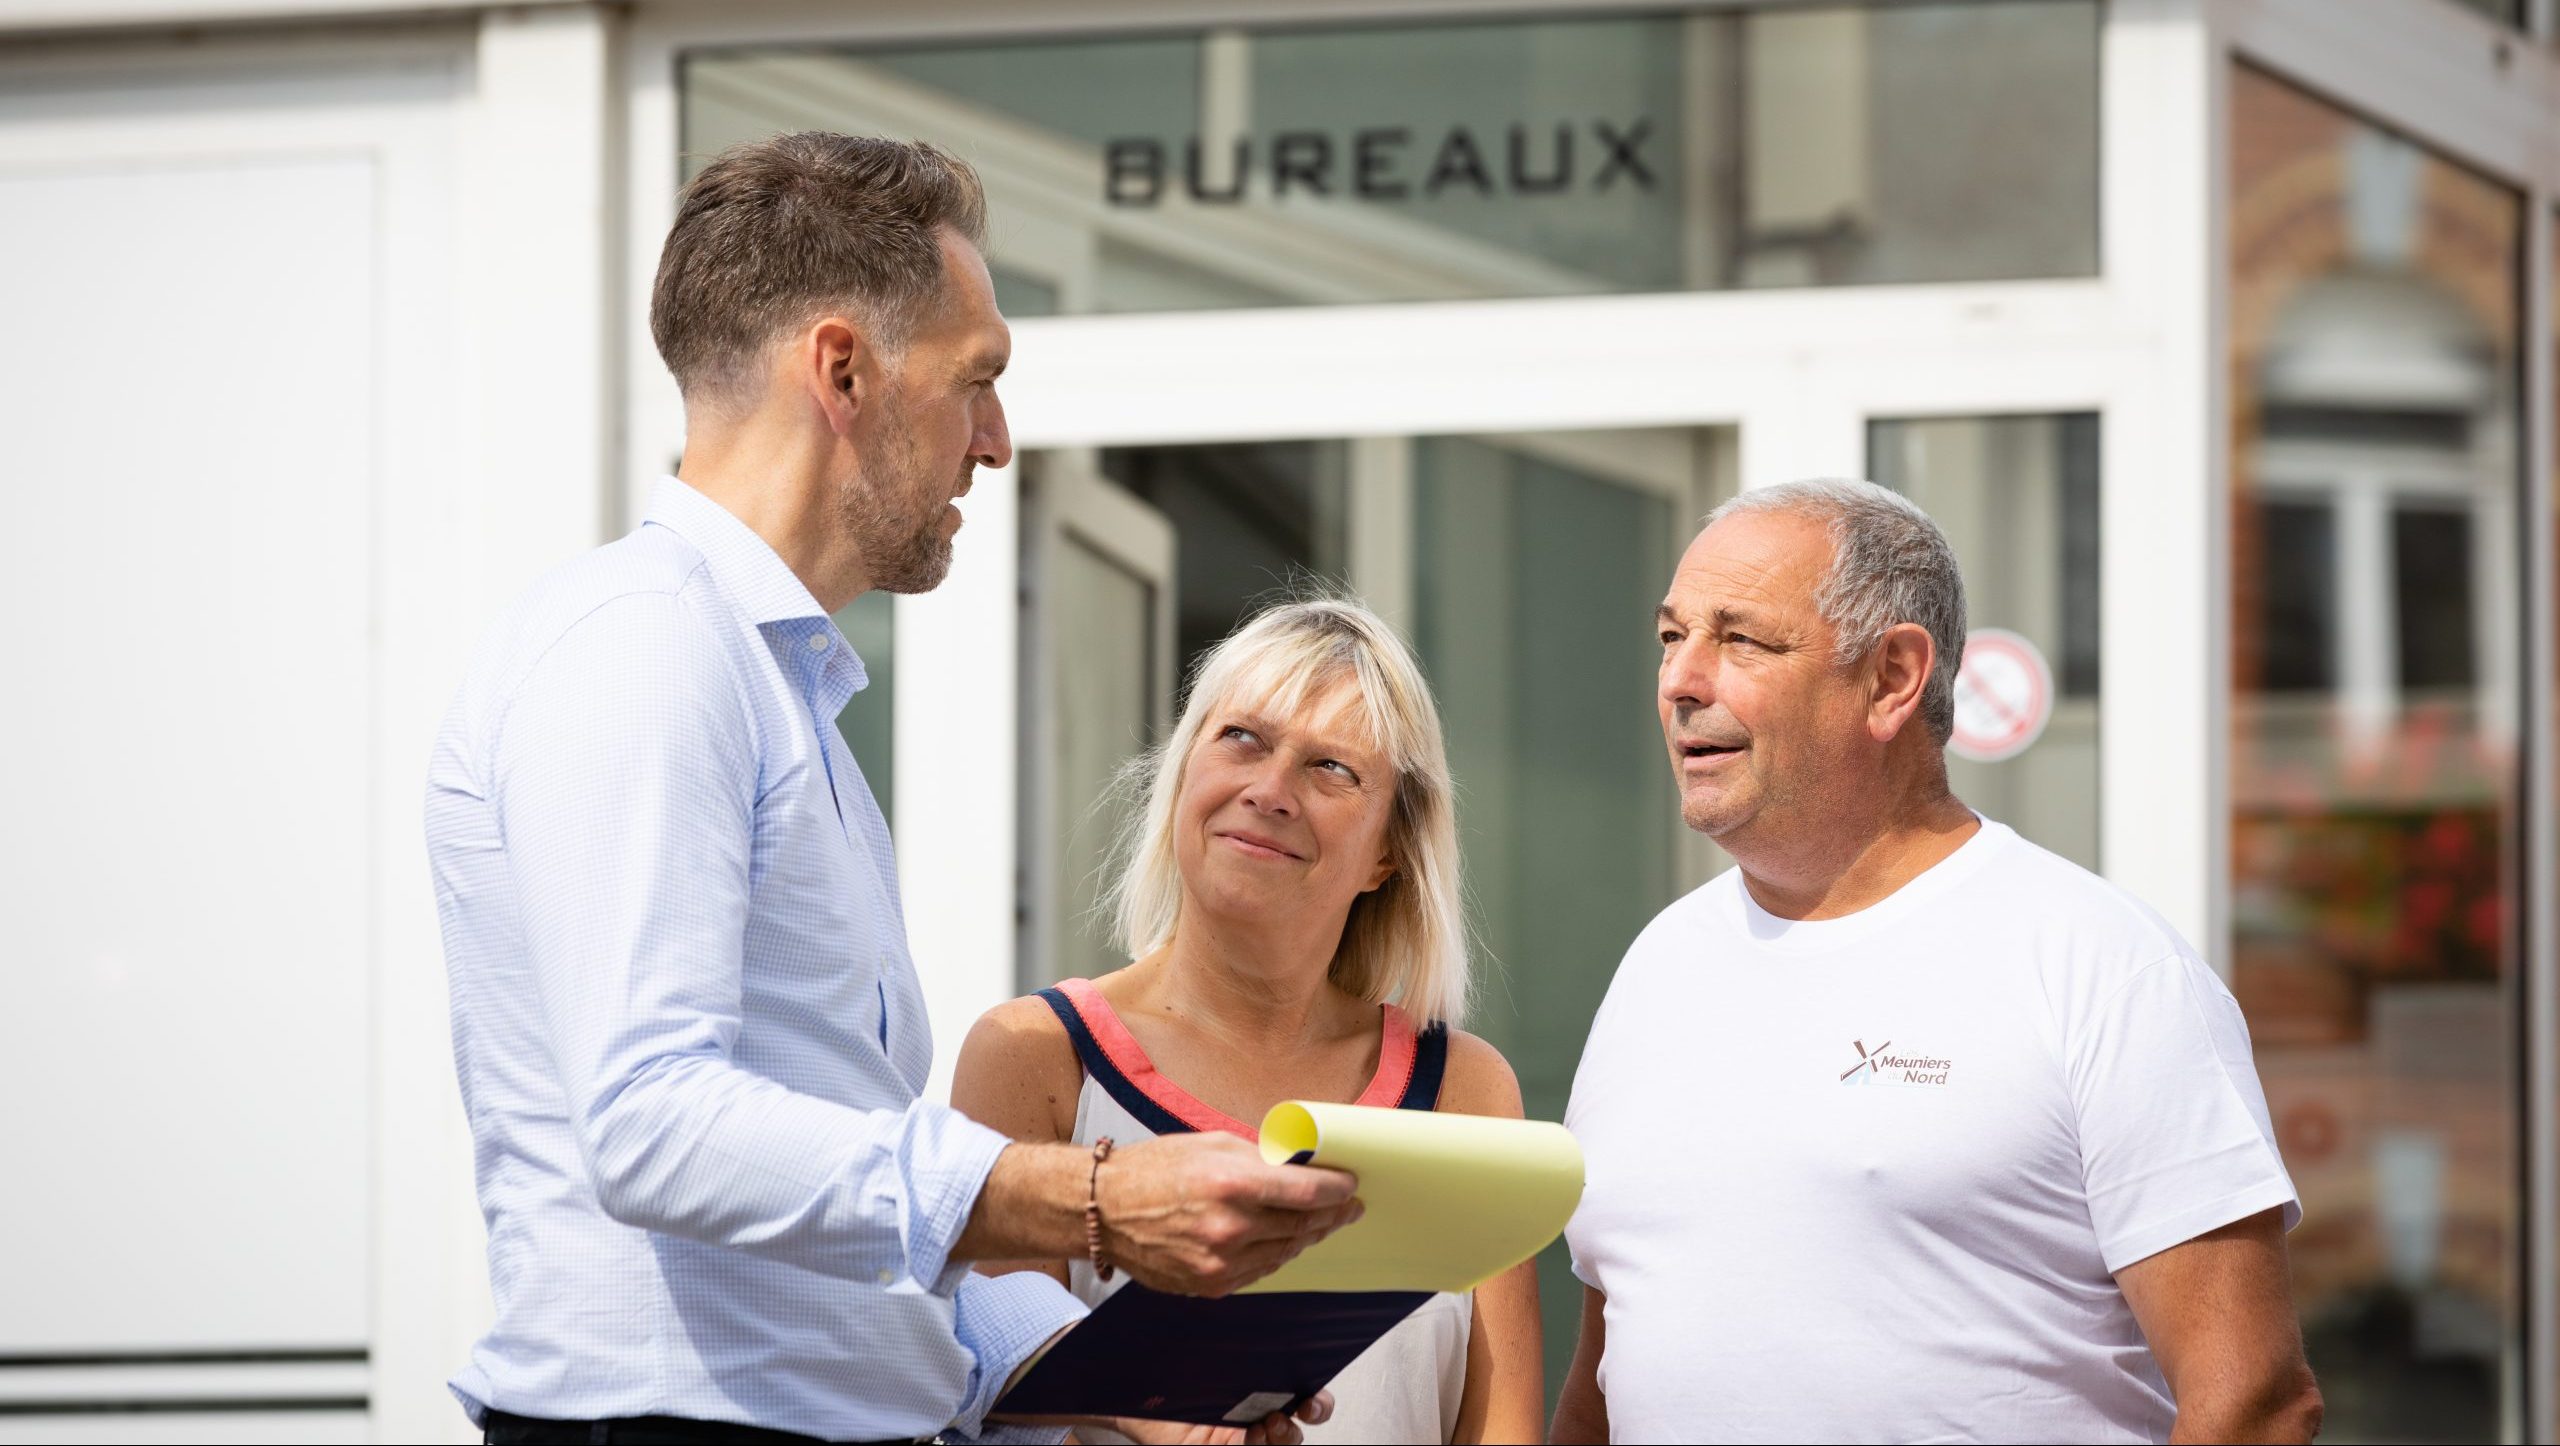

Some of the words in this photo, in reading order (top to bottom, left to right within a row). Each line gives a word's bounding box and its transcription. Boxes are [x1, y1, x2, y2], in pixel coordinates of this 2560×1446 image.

[1105, 119, 1657, 207] BUREAUX
[1880, 1055, 1951, 1070] Meuniers
[1903, 1070, 1948, 1085] Nord
